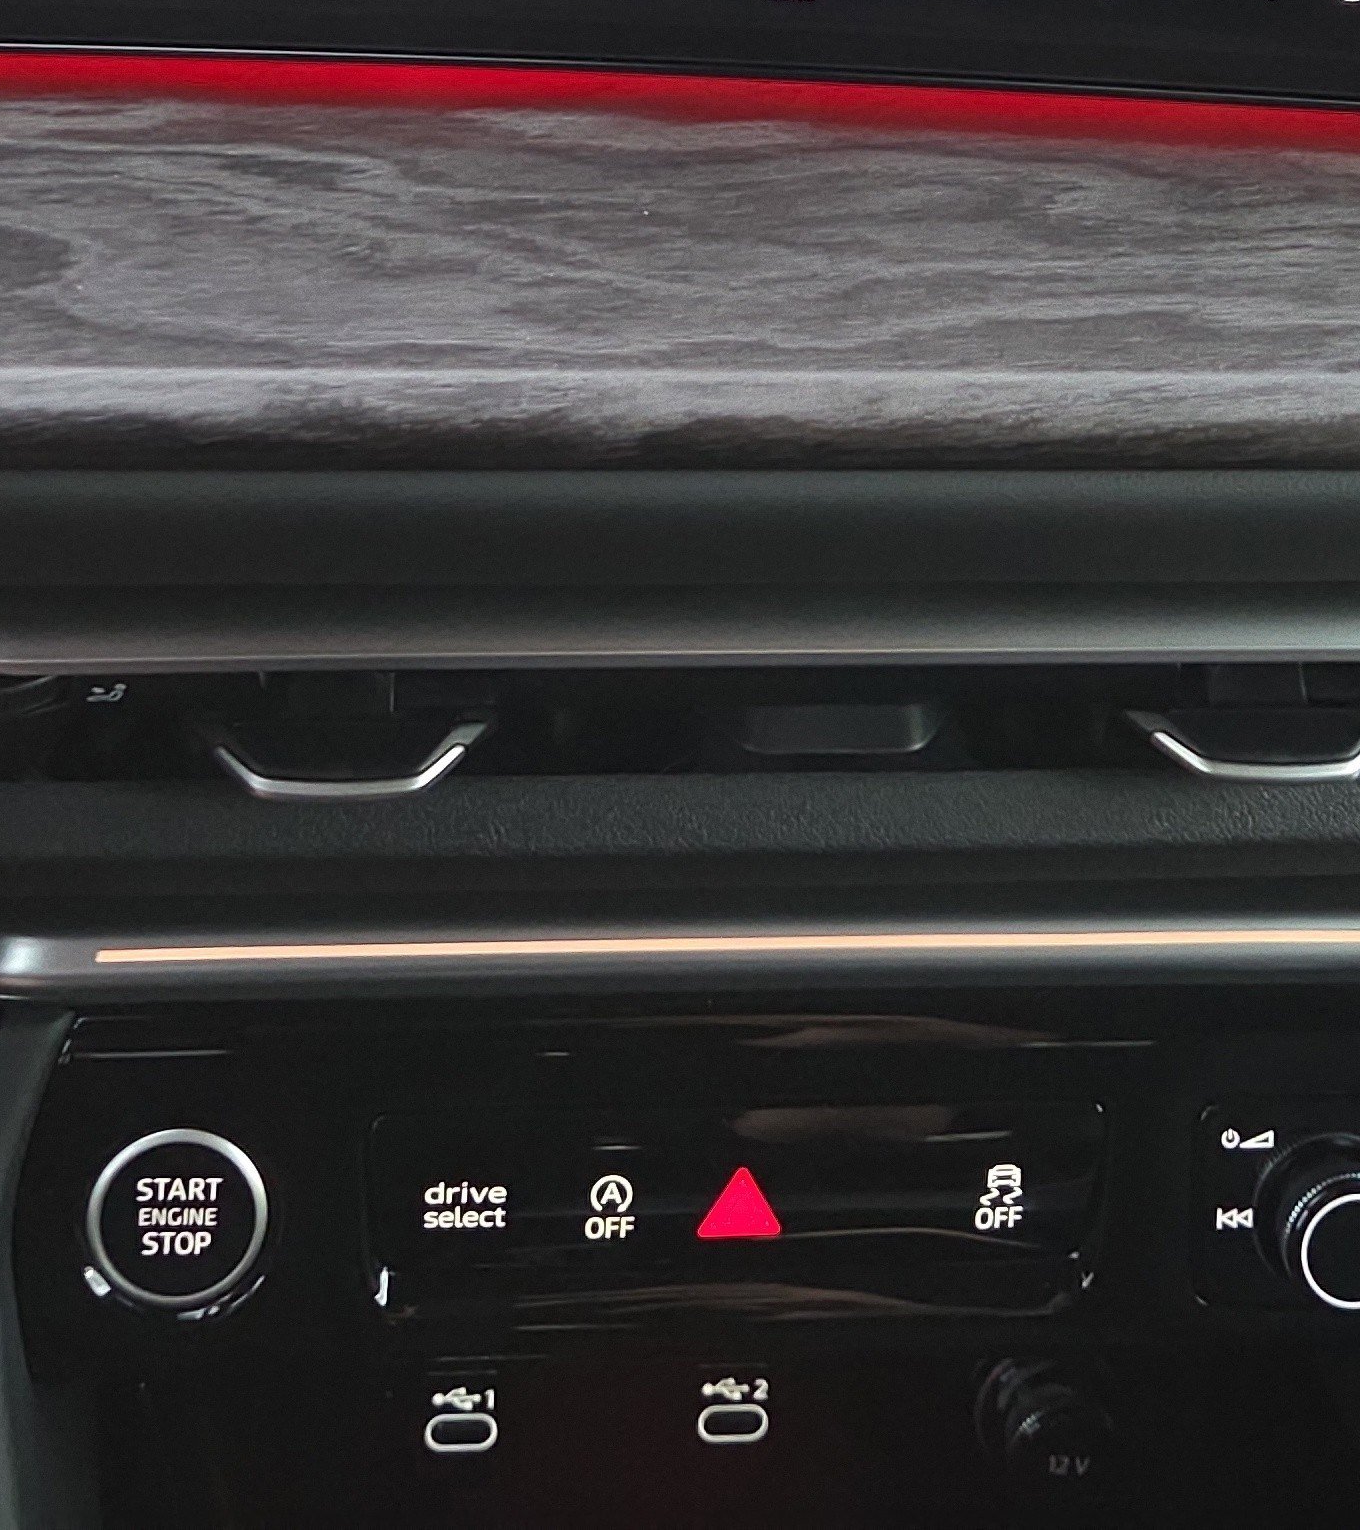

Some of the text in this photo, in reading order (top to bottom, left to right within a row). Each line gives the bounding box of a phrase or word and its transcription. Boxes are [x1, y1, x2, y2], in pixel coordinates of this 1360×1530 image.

[135, 1177, 224, 1202] START
[424, 1181, 508, 1206] drive
[137, 1207, 219, 1227] ENGINE
[423, 1206, 507, 1230] select
[584, 1215, 636, 1240] OFF
[974, 1205, 1024, 1231] OFF
[140, 1231, 212, 1256] STOP
[482, 1388, 497, 1412] 1
[753, 1378, 769, 1401] 2
